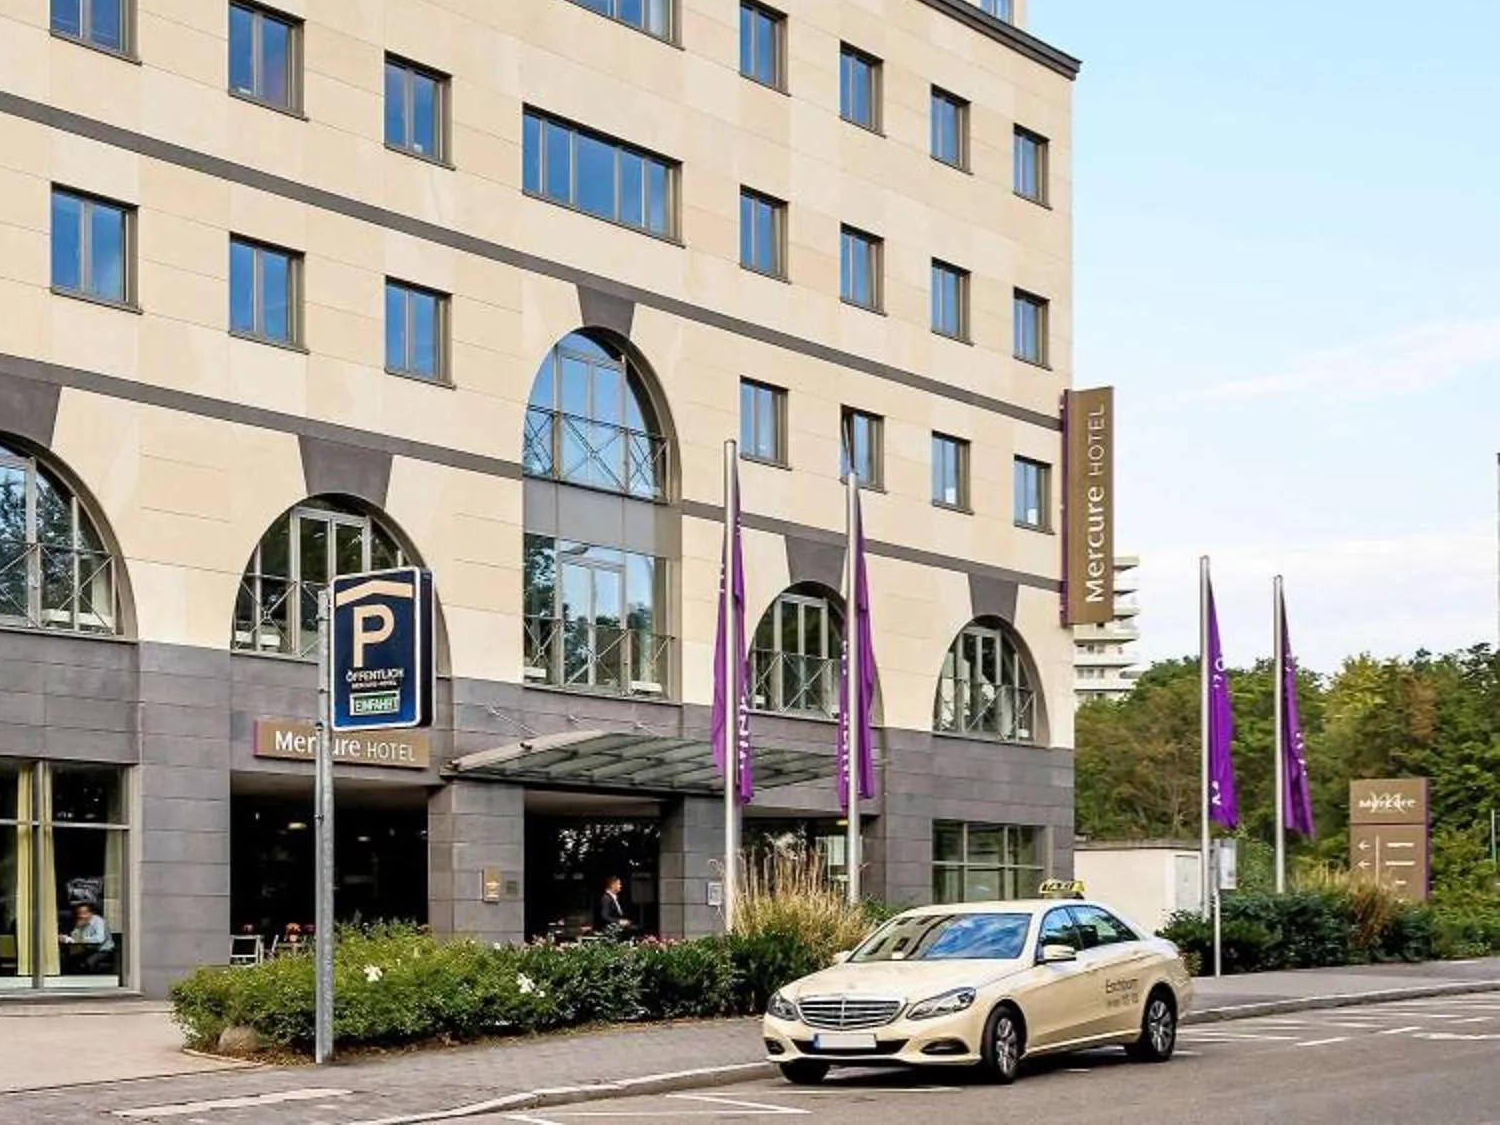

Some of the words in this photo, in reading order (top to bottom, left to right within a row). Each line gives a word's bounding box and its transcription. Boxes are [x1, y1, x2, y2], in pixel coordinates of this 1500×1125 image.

[1088, 404, 1105, 476] HOTEL
[1085, 486, 1105, 603] Mercure
[353, 604, 394, 668] P
[275, 730, 360, 757] Merure
[367, 741, 416, 762] HOTEL
